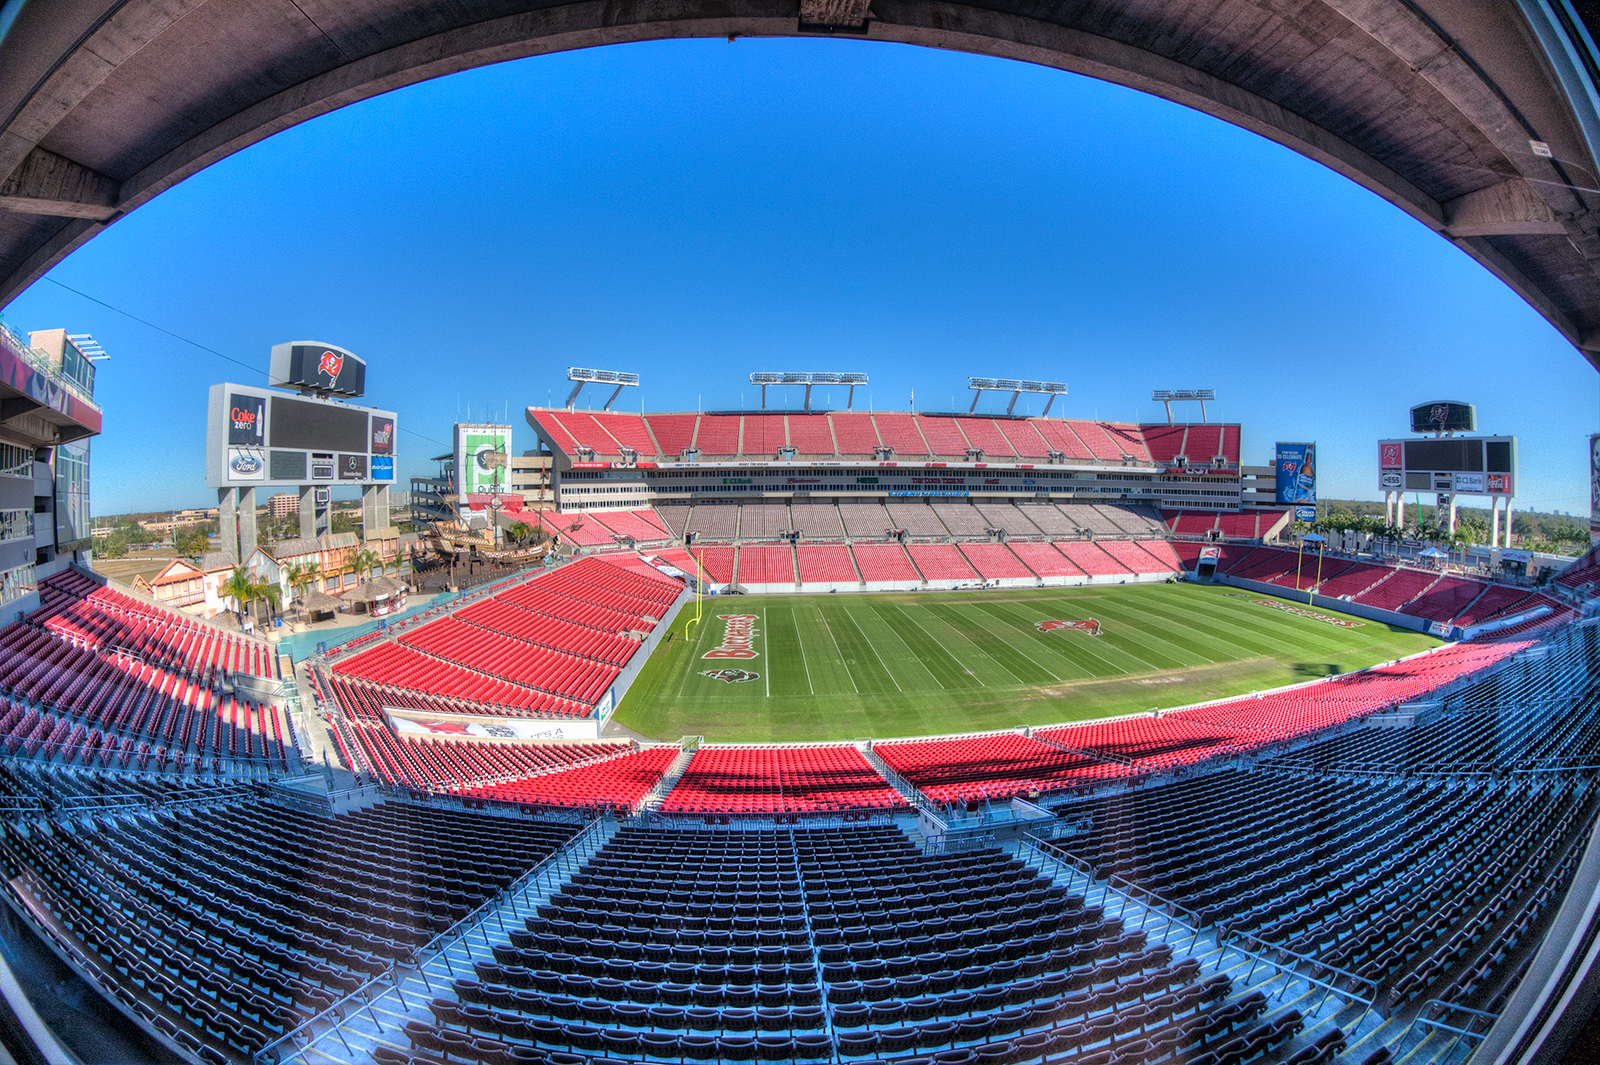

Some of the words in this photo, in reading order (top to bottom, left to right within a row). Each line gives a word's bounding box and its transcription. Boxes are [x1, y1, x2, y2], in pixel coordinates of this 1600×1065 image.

[231, 407, 256, 424] Coke
[234, 421, 252, 430] zero
[236, 458, 257, 472] Ford
[1384, 476, 1400, 484] HESS
[1469, 476, 1482, 485] Bank
